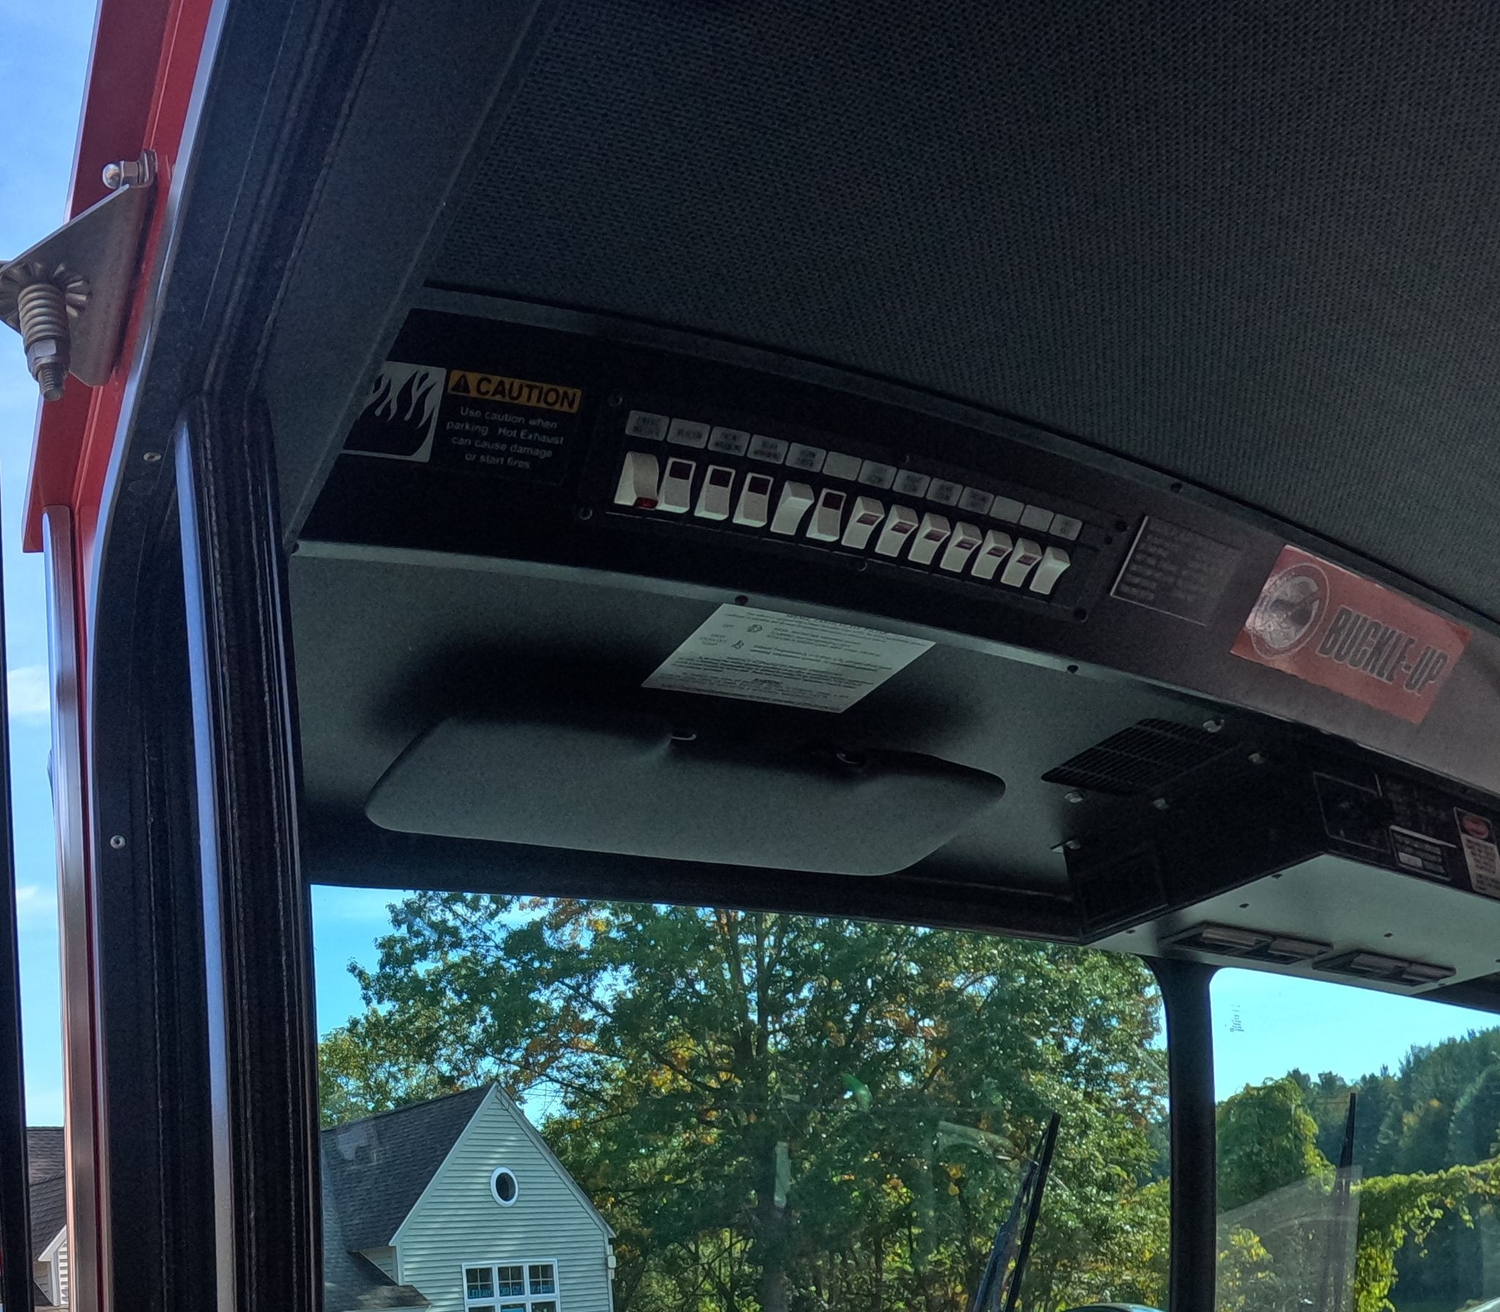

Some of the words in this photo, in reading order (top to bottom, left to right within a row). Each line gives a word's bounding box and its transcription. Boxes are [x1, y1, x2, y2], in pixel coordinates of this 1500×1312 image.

[476, 377, 578, 410] CAUTION
[460, 406, 482, 418] Use
[484, 411, 526, 424] caution
[528, 417, 558, 429] when
[451, 436, 472, 446] can
[474, 438, 507, 451] cause
[509, 443, 553, 459] damage
[497, 426, 518, 438] Hot
[519, 429, 565, 446] Exhaust
[464, 453, 477, 462] or
[479, 453, 505, 466] start
